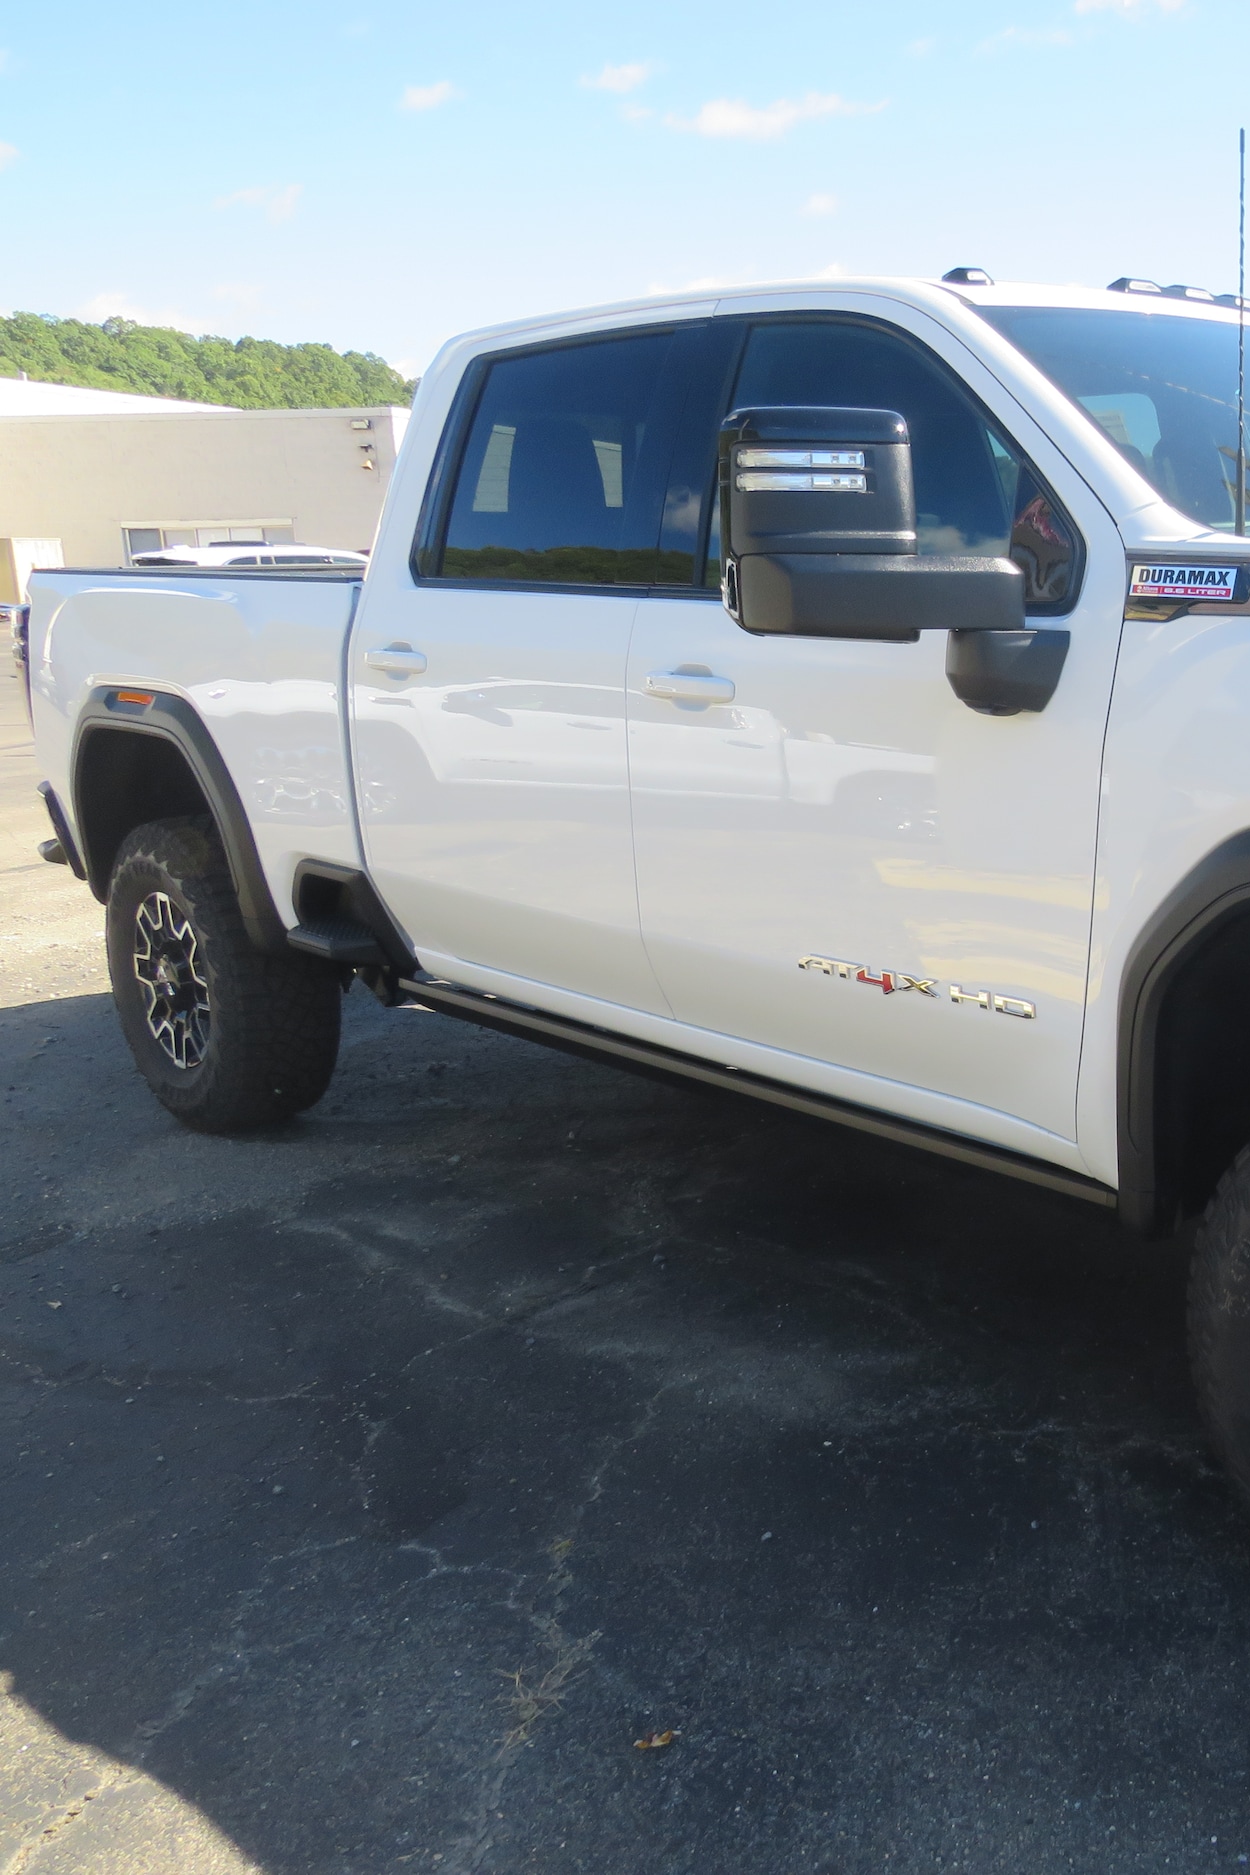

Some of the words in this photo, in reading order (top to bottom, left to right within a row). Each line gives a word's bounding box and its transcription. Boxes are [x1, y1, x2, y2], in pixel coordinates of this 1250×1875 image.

[1138, 568, 1230, 586] DURAMAX
[1187, 588, 1227, 596] LITER
[798, 953, 941, 998] AT4X
[950, 983, 1037, 1019] HD
